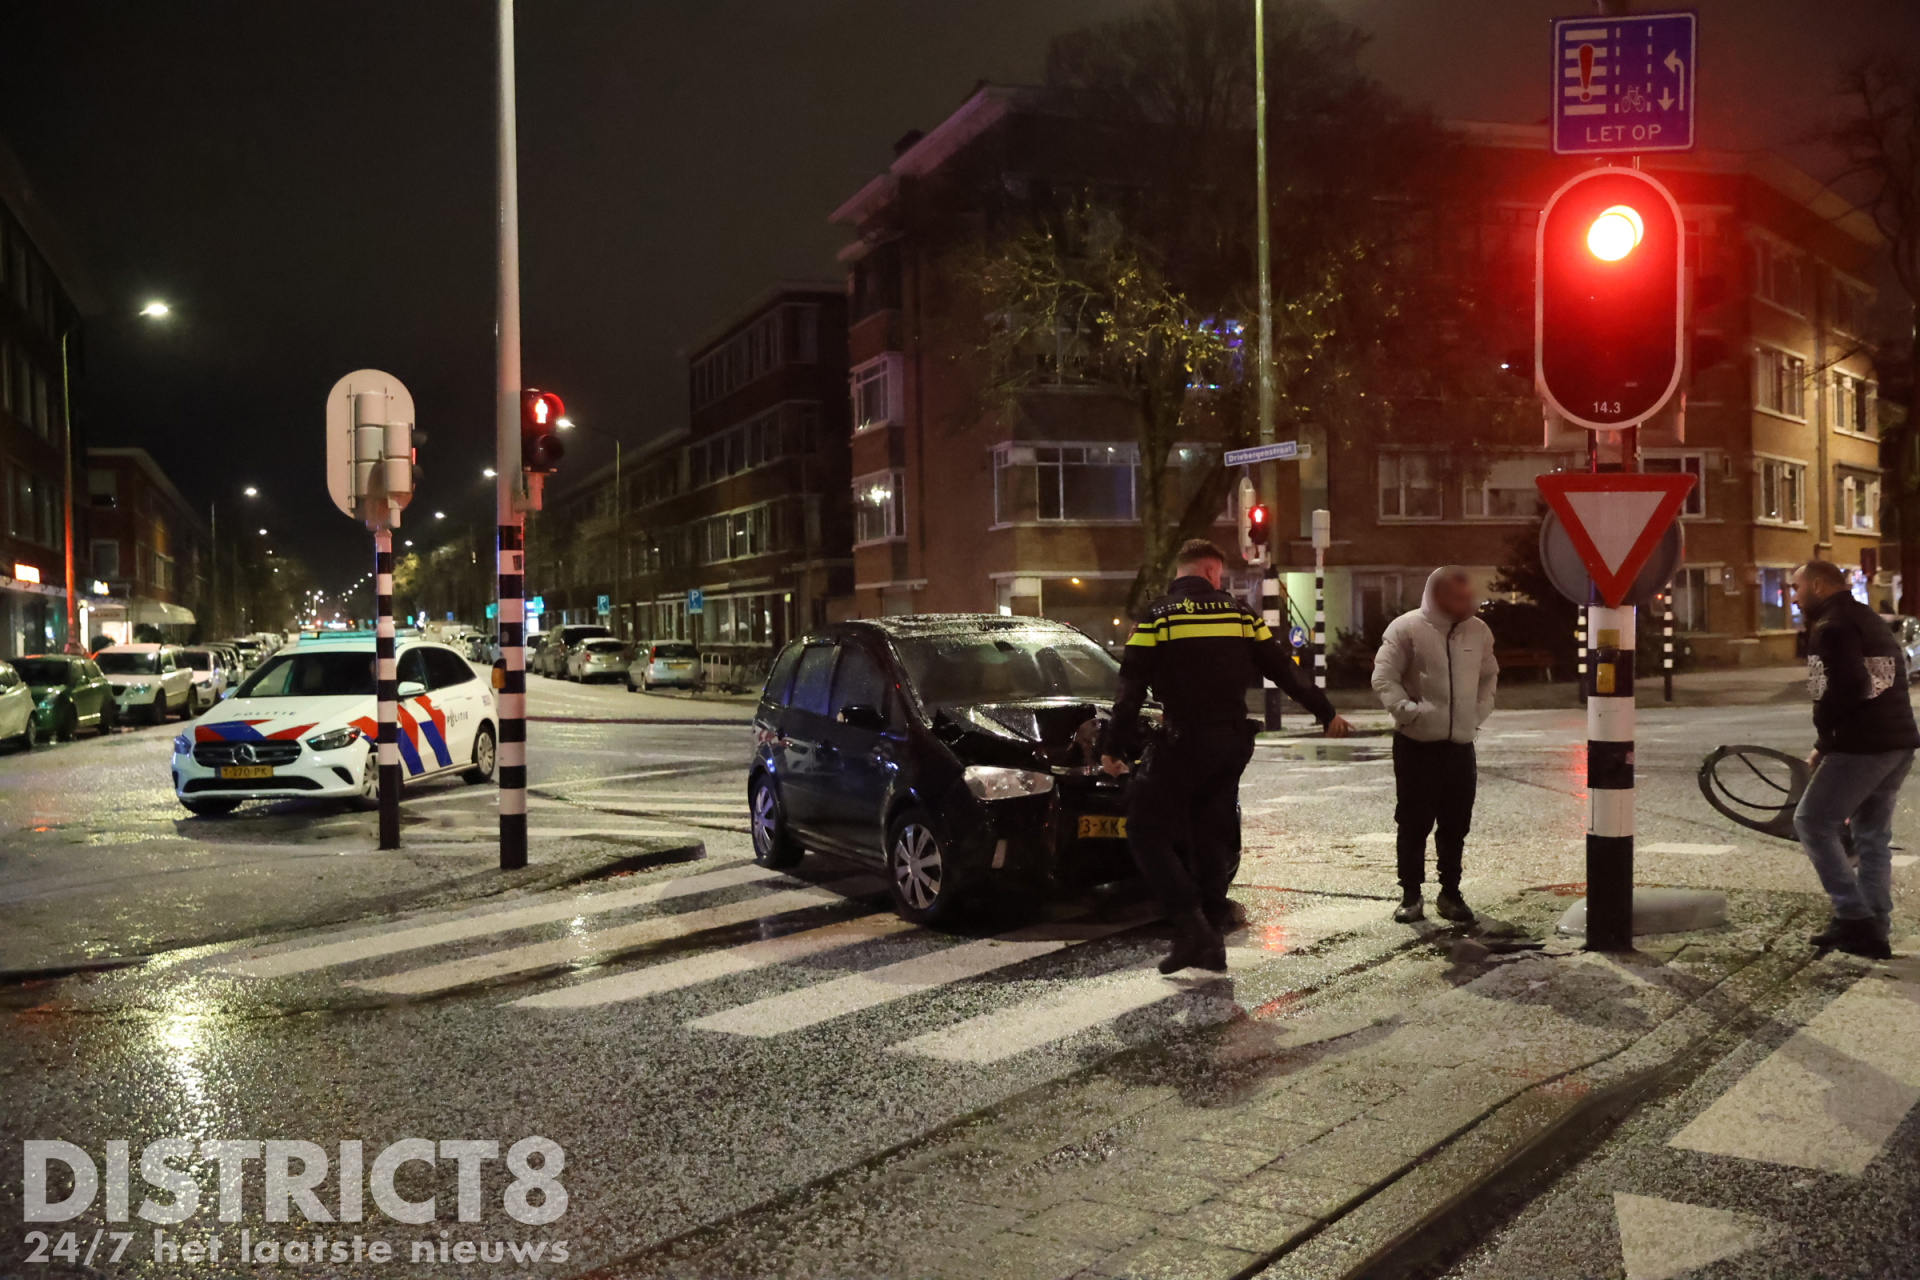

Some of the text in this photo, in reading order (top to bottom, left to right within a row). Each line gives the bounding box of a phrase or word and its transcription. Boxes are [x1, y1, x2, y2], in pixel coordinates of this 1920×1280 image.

[1586, 124, 1662, 142] LET OP
[1593, 401, 1621, 414] 14.3
[1228, 445, 1292, 462] Driebergenstraat
[1176, 598, 1231, 613] POLITIE
